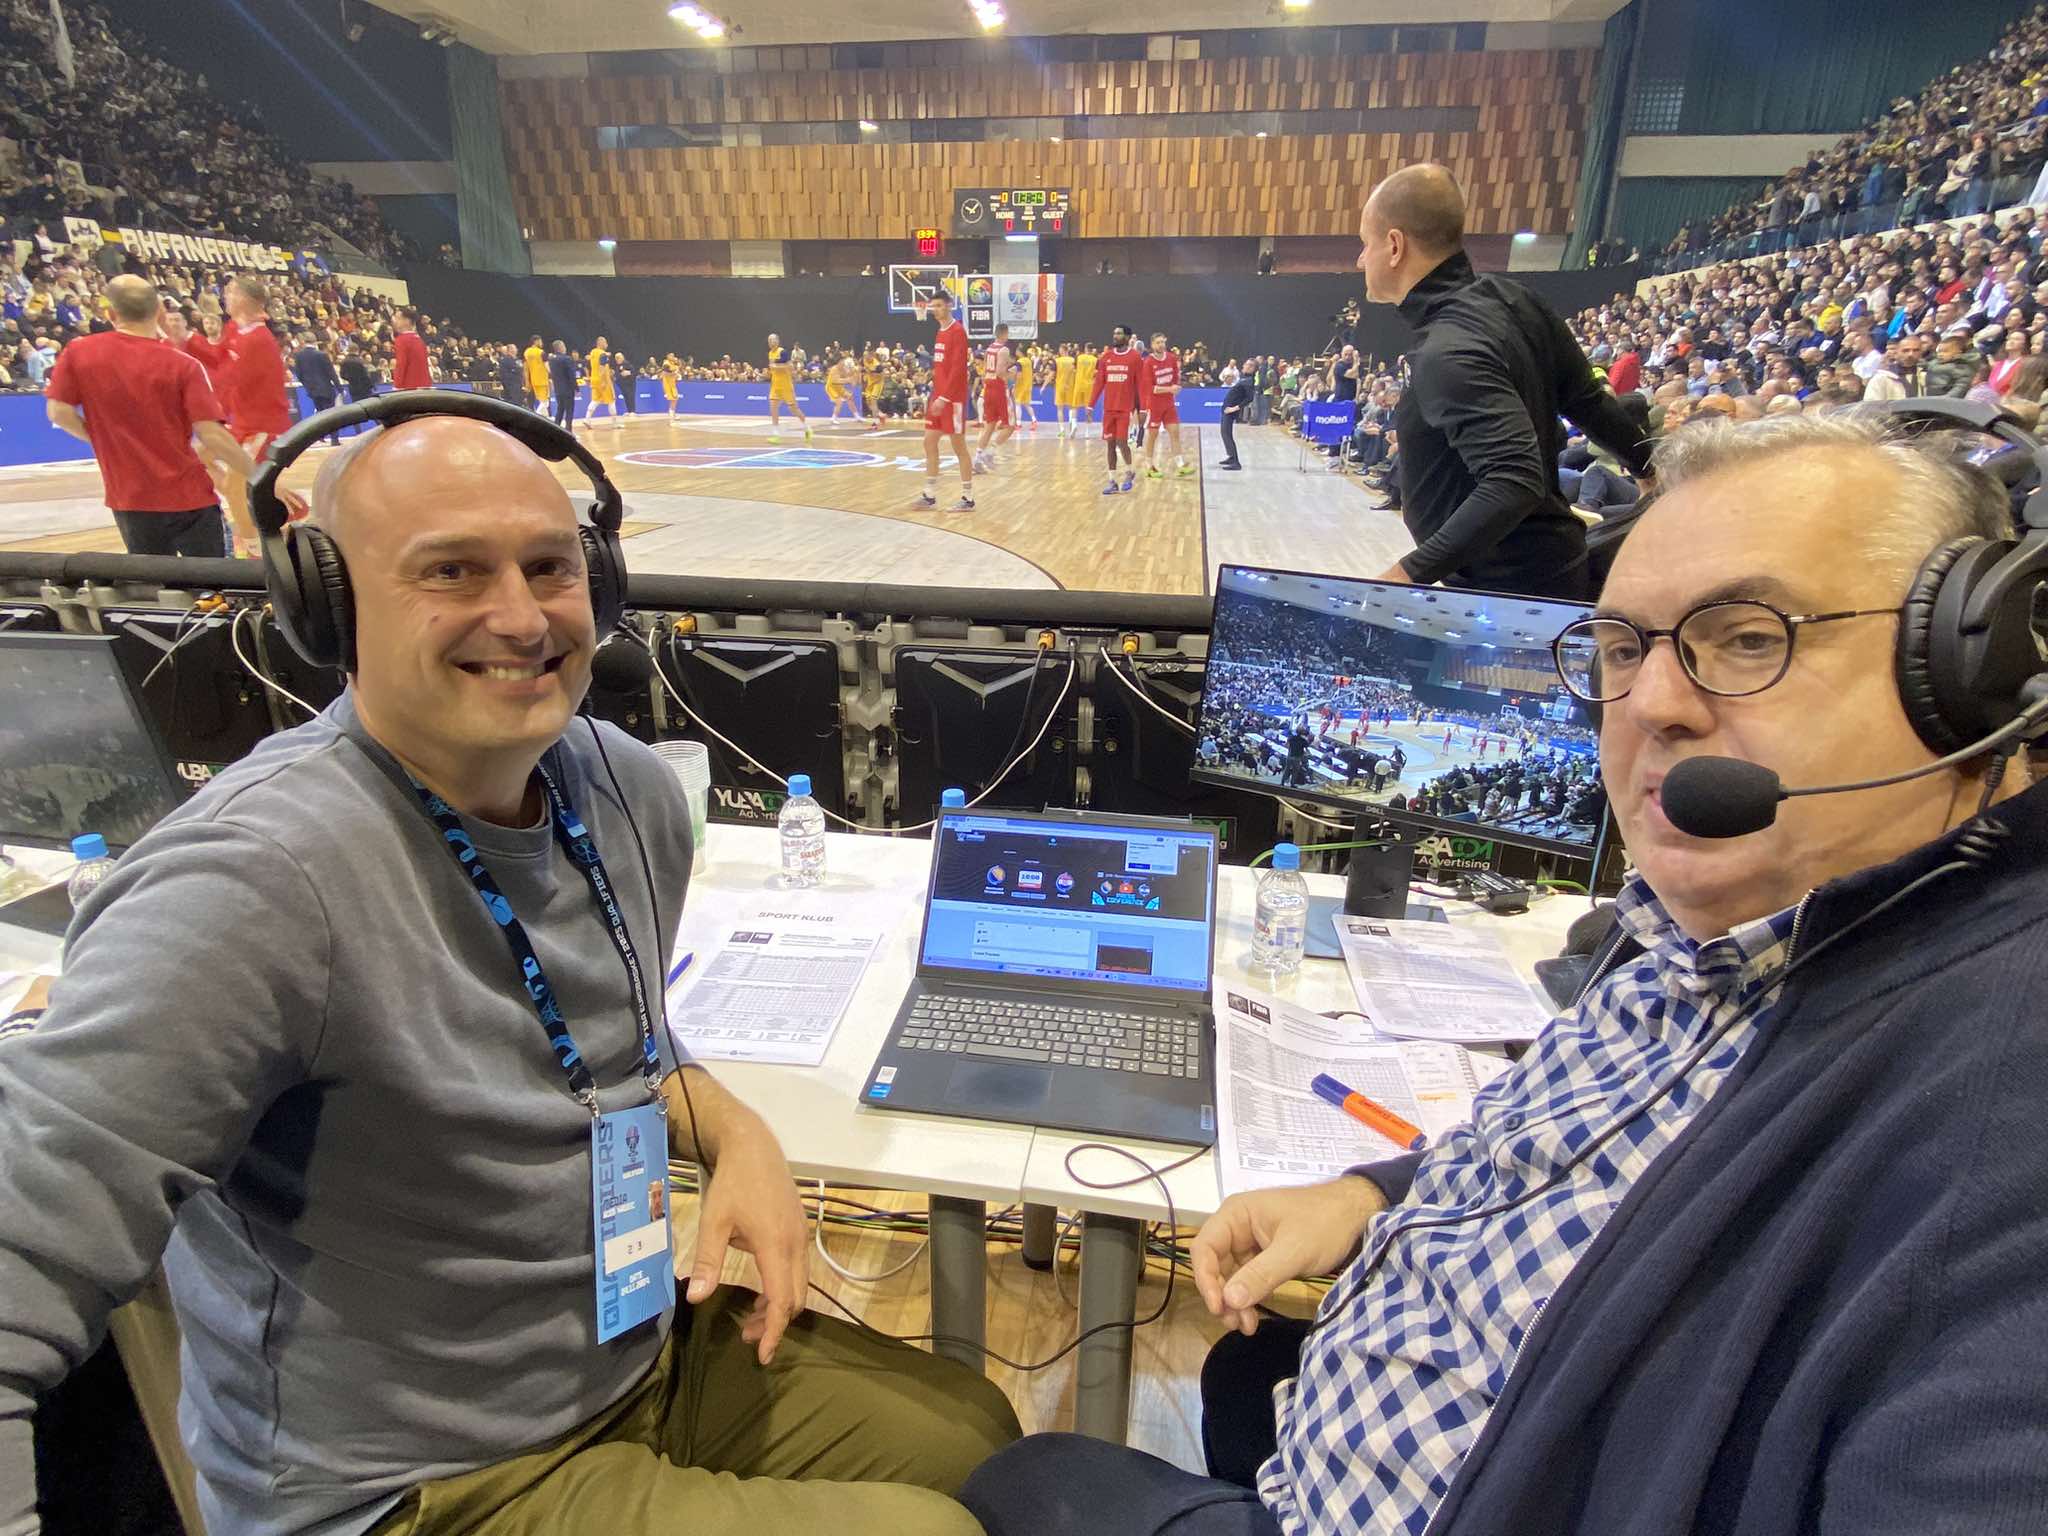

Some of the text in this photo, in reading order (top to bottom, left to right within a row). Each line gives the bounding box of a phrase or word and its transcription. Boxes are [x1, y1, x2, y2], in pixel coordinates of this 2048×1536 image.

[996, 211, 1015, 219] HOME
[1042, 211, 1064, 219] GUEST
[971, 310, 990, 320] FIBA
[1315, 415, 1348, 424] molten
[1365, 805, 1385, 816] DELL
[589, 865, 621, 928] QUALIFIERS
[757, 911, 834, 923] SPORT KLUB
[614, 926, 631, 952] 2025
[625, 952, 647, 1013] EUROBASKET
